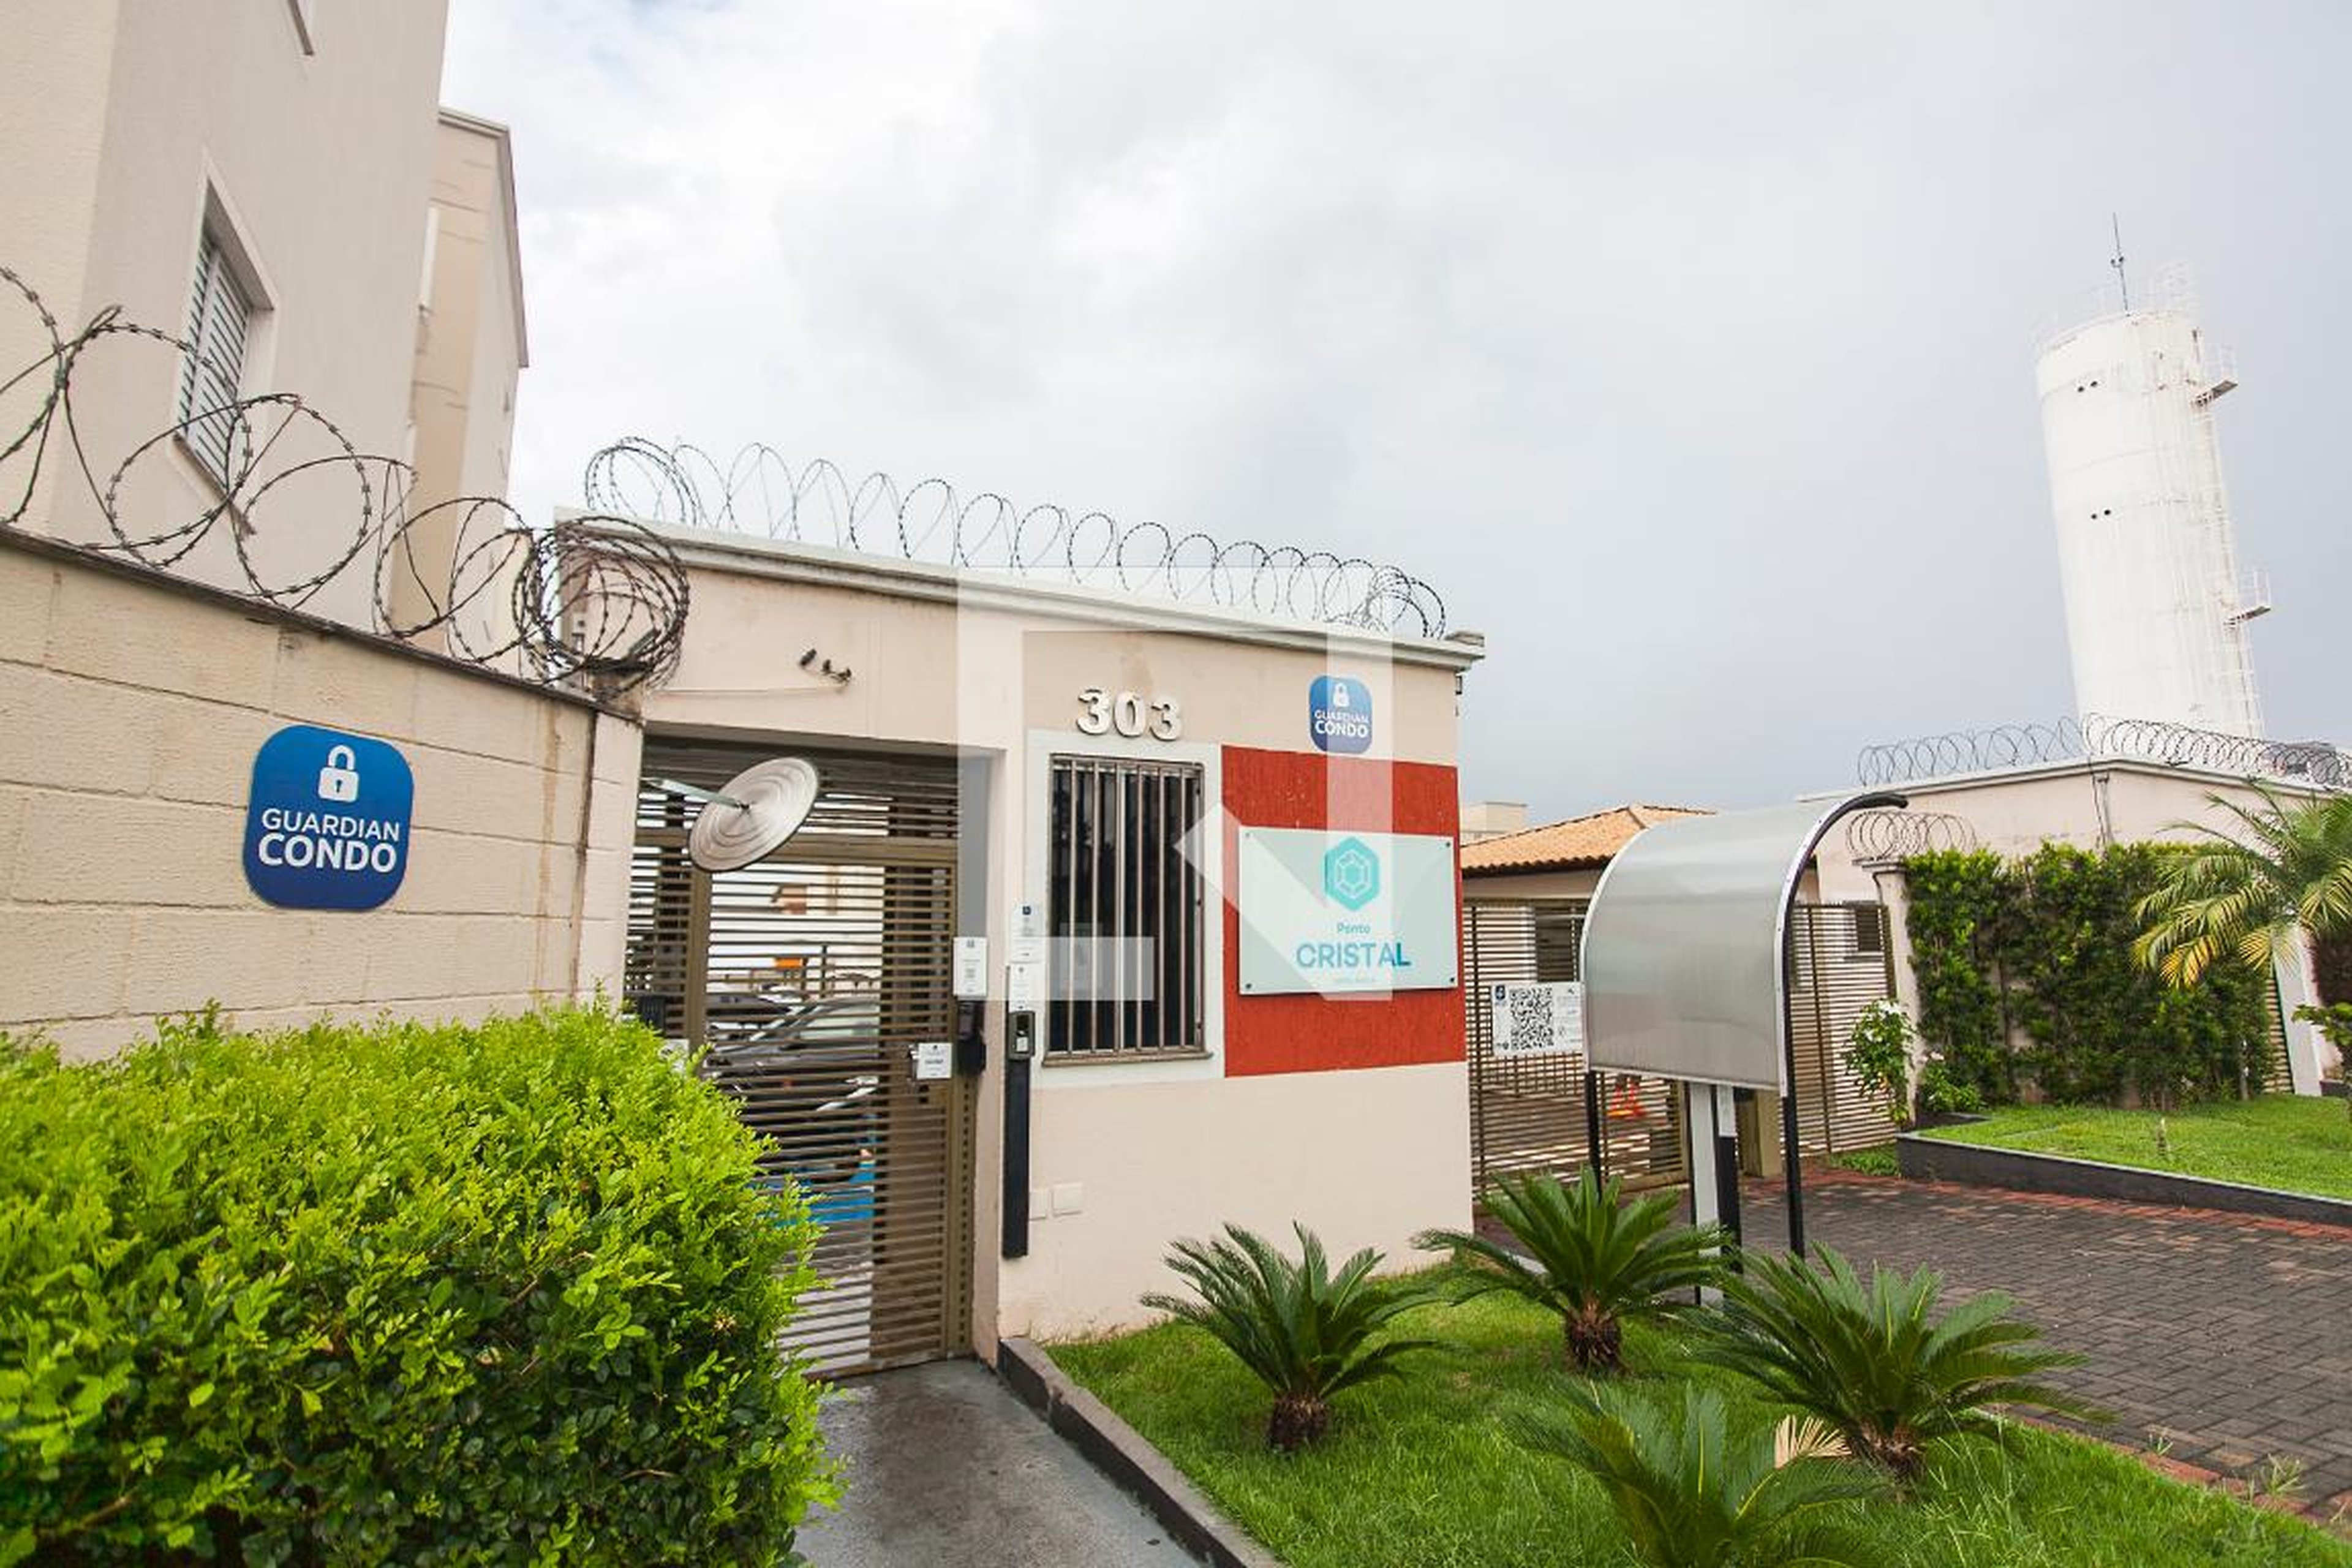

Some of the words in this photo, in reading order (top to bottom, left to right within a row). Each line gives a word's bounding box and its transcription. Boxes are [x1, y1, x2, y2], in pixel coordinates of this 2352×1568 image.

[1076, 688, 1182, 742] 303
[1314, 720, 1369, 738] CONDO
[262, 808, 400, 842] GUARDIAN
[258, 832, 397, 873] CONDO
[1295, 942, 1411, 968] CRISTAL
